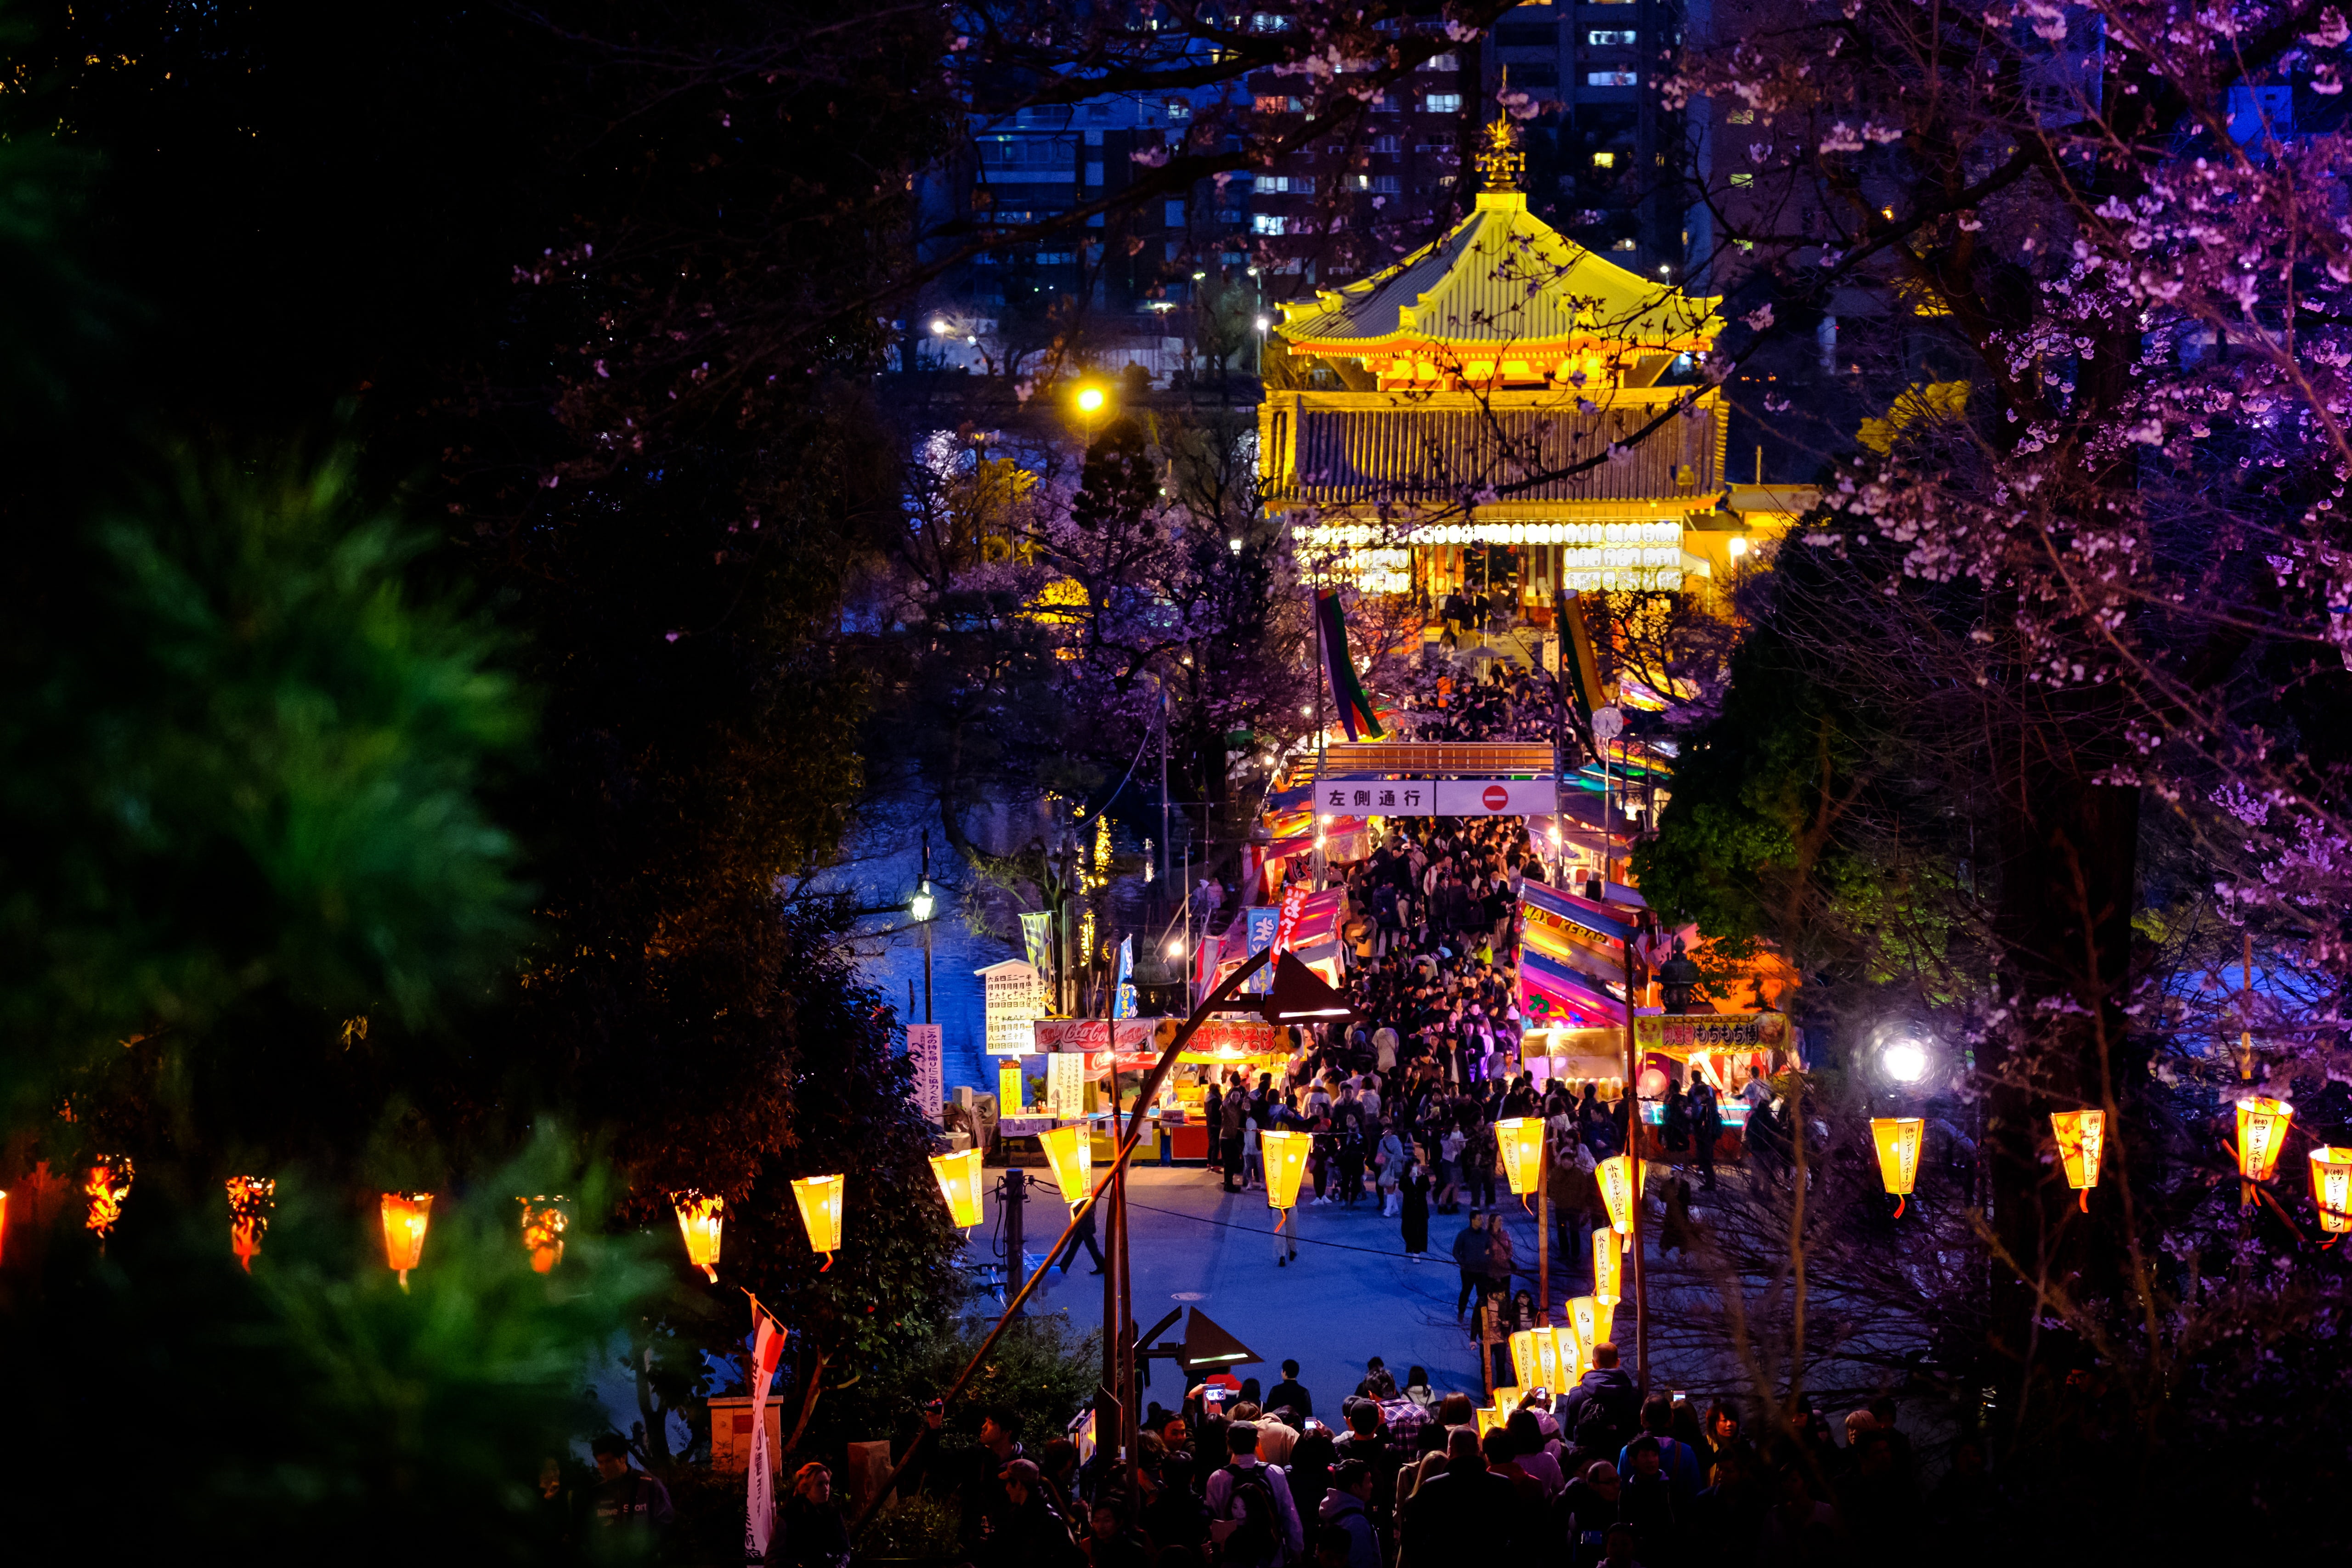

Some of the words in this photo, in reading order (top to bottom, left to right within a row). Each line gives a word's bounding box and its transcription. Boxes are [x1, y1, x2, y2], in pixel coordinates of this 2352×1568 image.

[1329, 790, 1420, 806] 左側通行
[1524, 905, 1554, 925] MAX
[1061, 1022, 1121, 1043] Coca-Cola
[927, 1027, 939, 1112] ごみの持ち帰りにご協力ください
